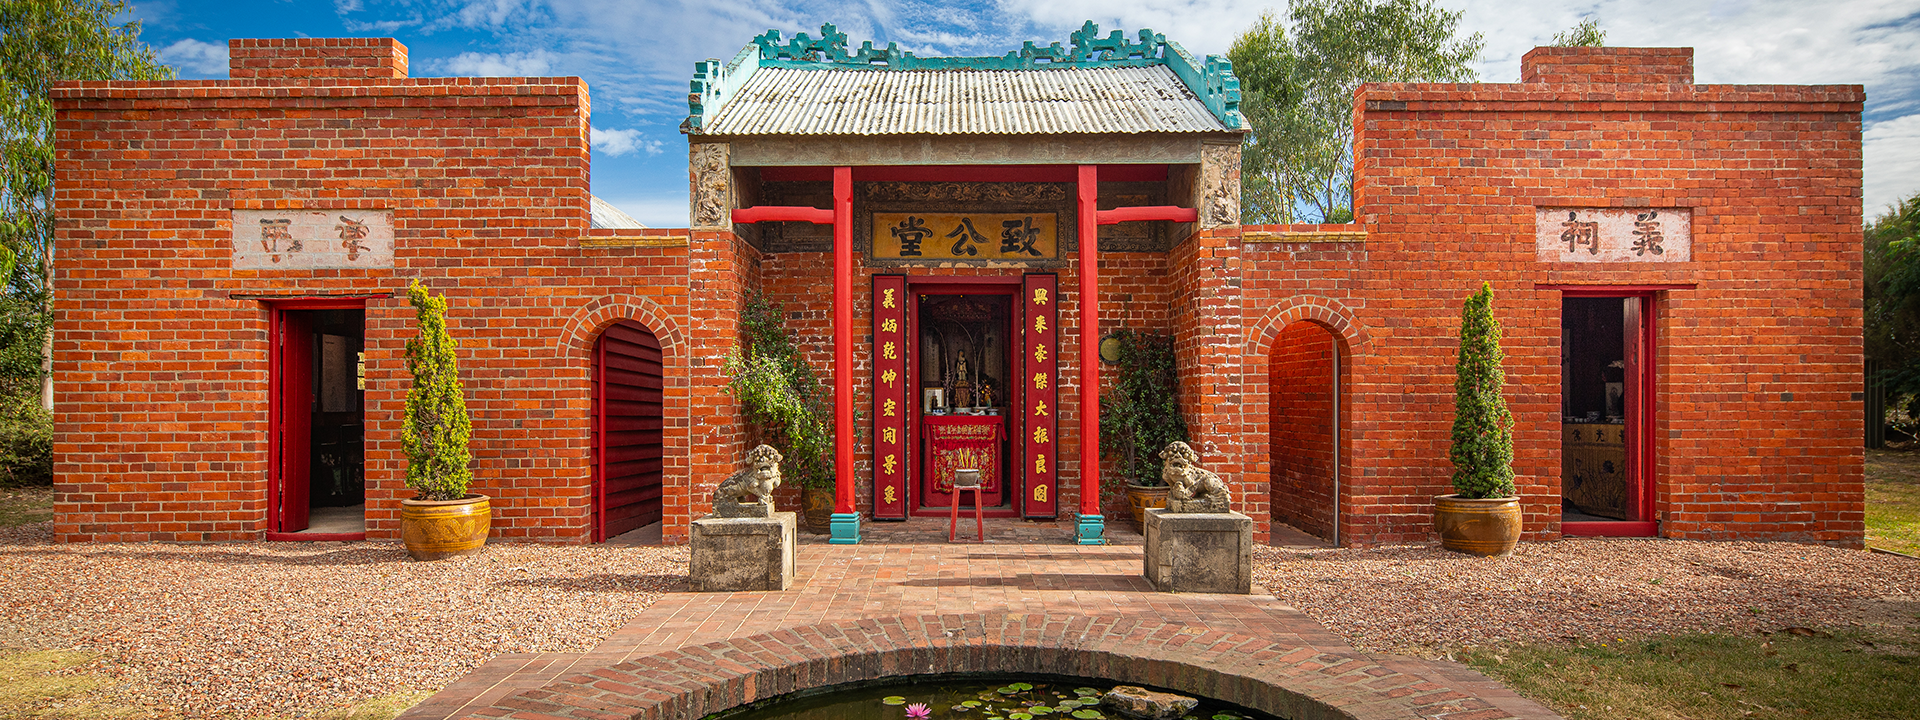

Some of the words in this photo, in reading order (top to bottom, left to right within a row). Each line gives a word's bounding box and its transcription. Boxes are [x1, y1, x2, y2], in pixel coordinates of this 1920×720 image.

[890, 215, 1043, 257] 致公堂
[1560, 211, 1664, 256] 義祠
